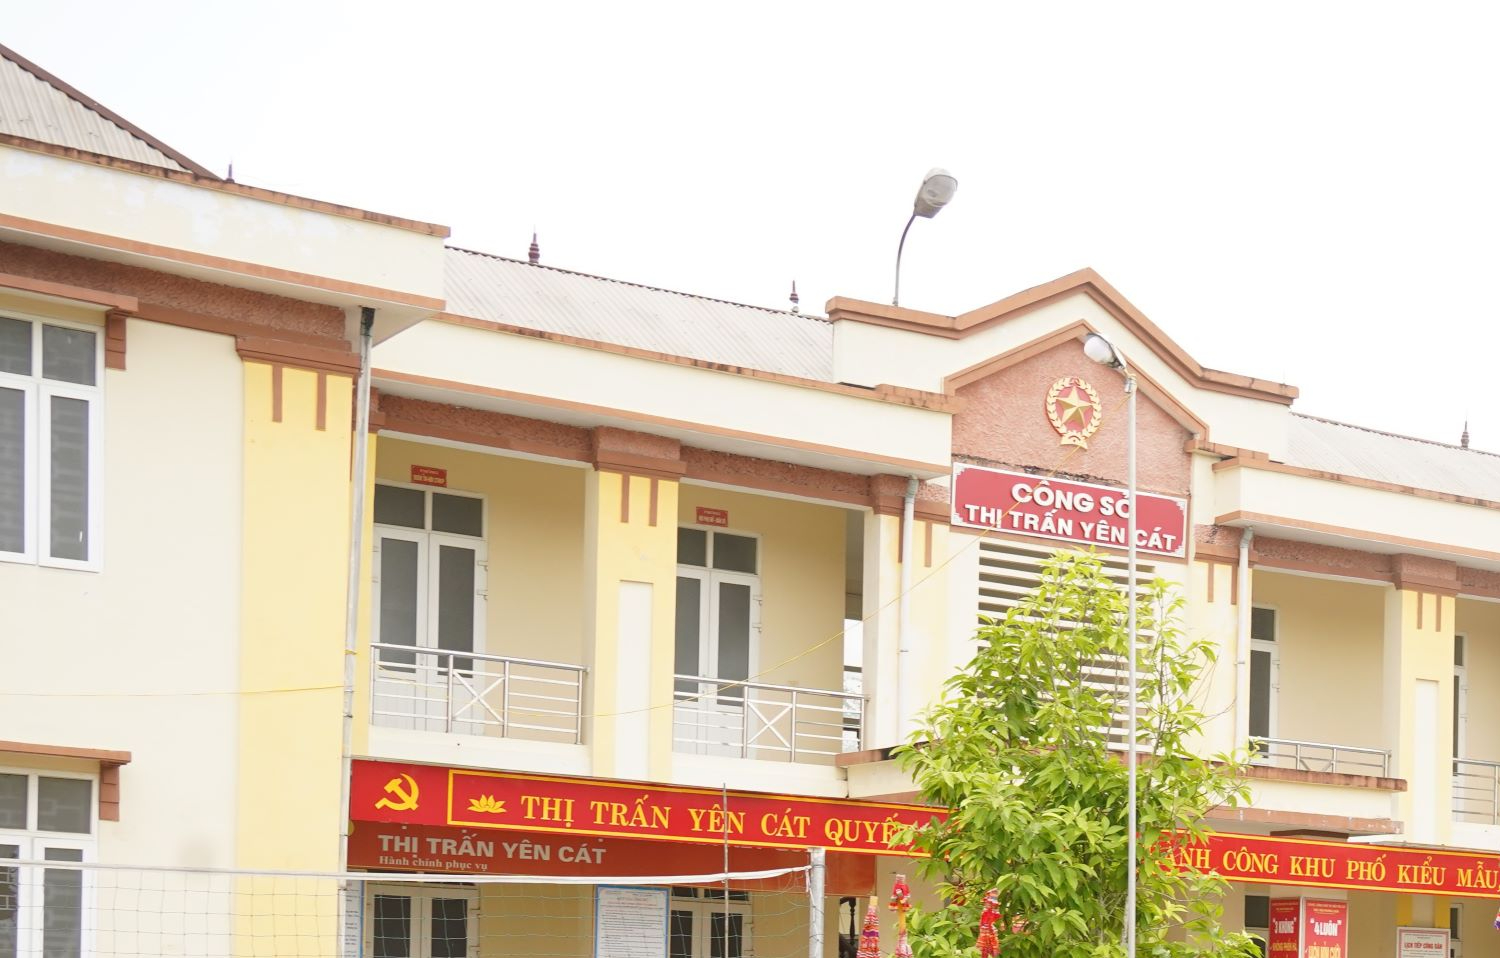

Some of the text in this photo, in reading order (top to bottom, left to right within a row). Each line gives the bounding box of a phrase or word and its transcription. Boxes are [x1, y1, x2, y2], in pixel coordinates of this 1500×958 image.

[1011, 479, 1095, 513] CÔNG
[965, 504, 1177, 551] THỊ TRẤN YÊN CÁT
[377, 833, 607, 865] THỊ TRẤN YÊN CÁT
[520, 796, 575, 828] THỊ
[590, 795, 672, 830] TRẤN
[690, 803, 746, 835] YÊN
[760, 808, 811, 839] CÁT
[824, 812, 914, 846] QUYẾ
[1222, 846, 1279, 875] CÔNG
[1289, 855, 1336, 882] KHU
[1345, 851, 1388, 884] PHỐ
[1397, 853, 1447, 887] KIỂU
[379, 855, 489, 872] Hành chính phục vụ
